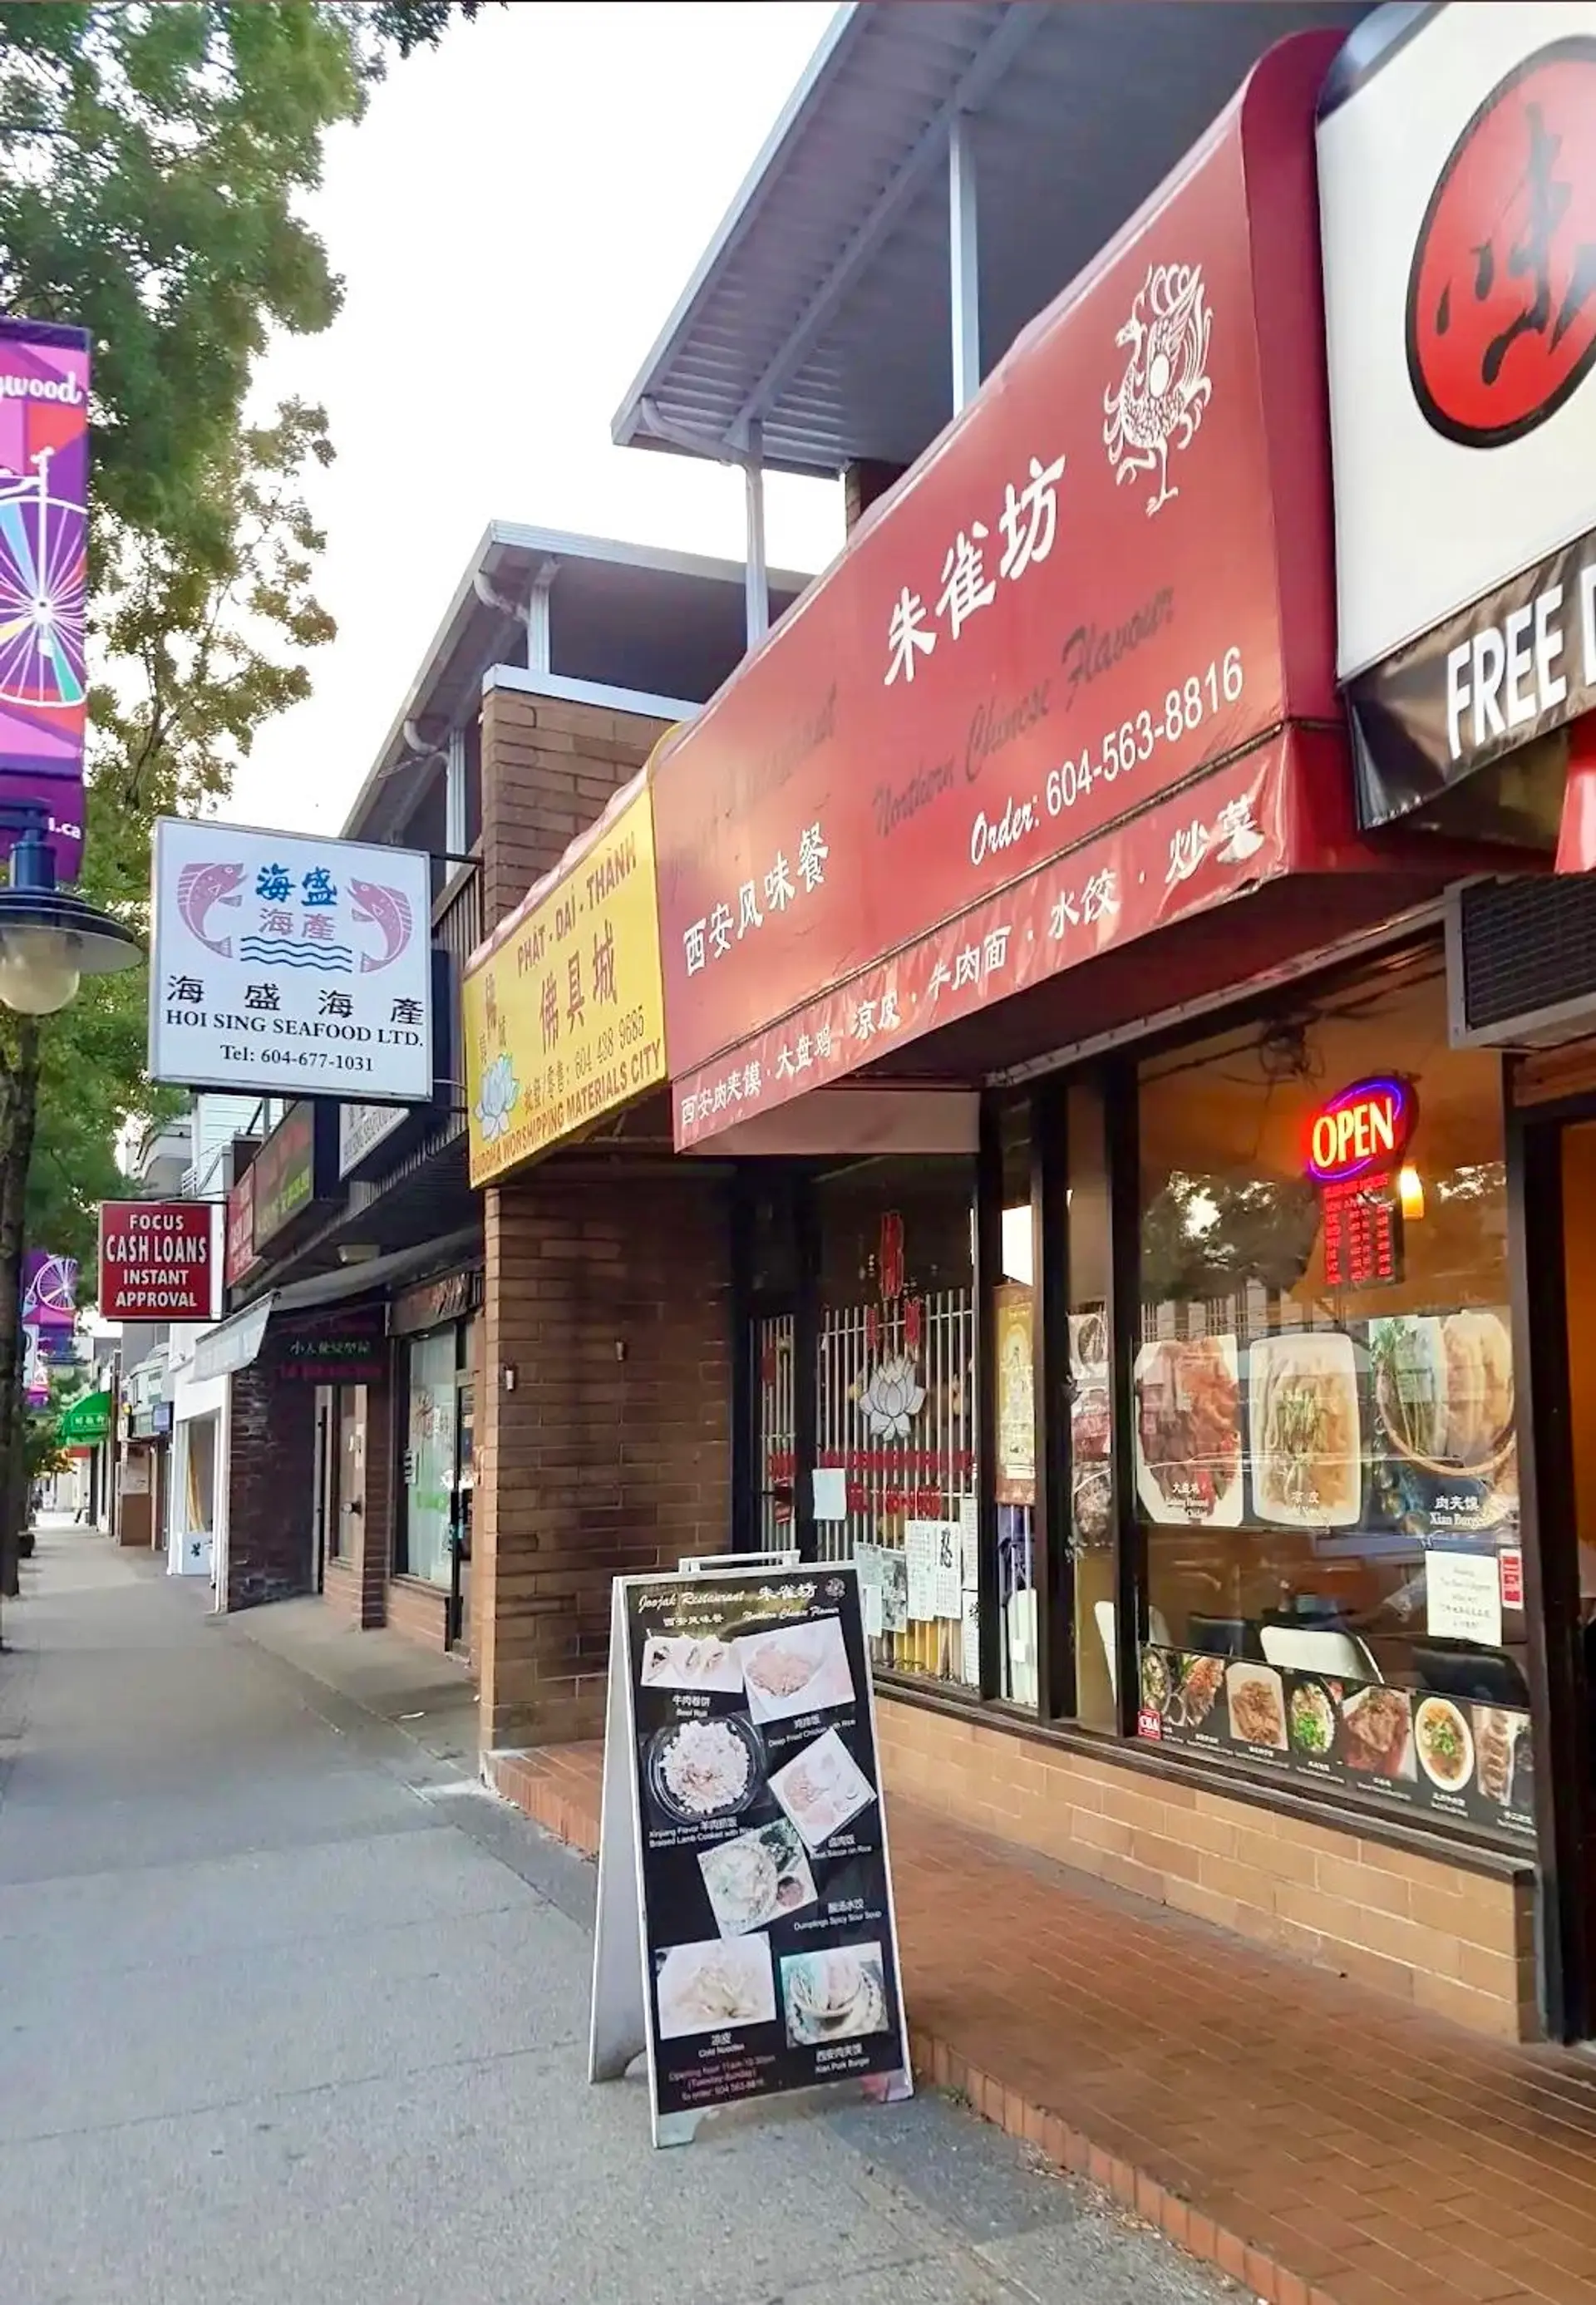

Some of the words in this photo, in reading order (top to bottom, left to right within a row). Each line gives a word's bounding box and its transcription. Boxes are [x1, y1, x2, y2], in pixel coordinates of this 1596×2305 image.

[884, 454, 1067, 687] 朱雀坊
[1447, 583, 1567, 760] FREE
[970, 795, 1040, 866] Order:
[1046, 645, 1244, 813] 604-563-8816
[254, 863, 338, 907] 海盛
[682, 821, 830, 977] 西安风味餐
[258, 908, 336, 941] 海產
[928, 925, 1012, 1000] 牛肉面
[1049, 868, 1121, 940] 水饺
[167, 974, 424, 1027] 海盛海產
[166, 1009, 207, 1027] HOI
[213, 1014, 266, 1033] SING
[273, 1019, 372, 1042] SEAFOOD
[377, 1029, 424, 1047] LTD.
[219, 1044, 255, 1061] Tel:
[261, 1049, 374, 1071] 604-677-1031
[502, 1102, 564, 1160] WORSHIPPING
[566, 1061, 628, 1123] MATERIALS
[631, 1037, 661, 1084] CITY
[1312, 1097, 1394, 1168] OPEN
[129, 1214, 185, 1230] FOCUS
[106, 1234, 149, 1263] CASH
[154, 1235, 207, 1263] LOANS
[116, 1291, 198, 1308] APPROVAL
[123, 1269, 190, 1285] INSTANT
